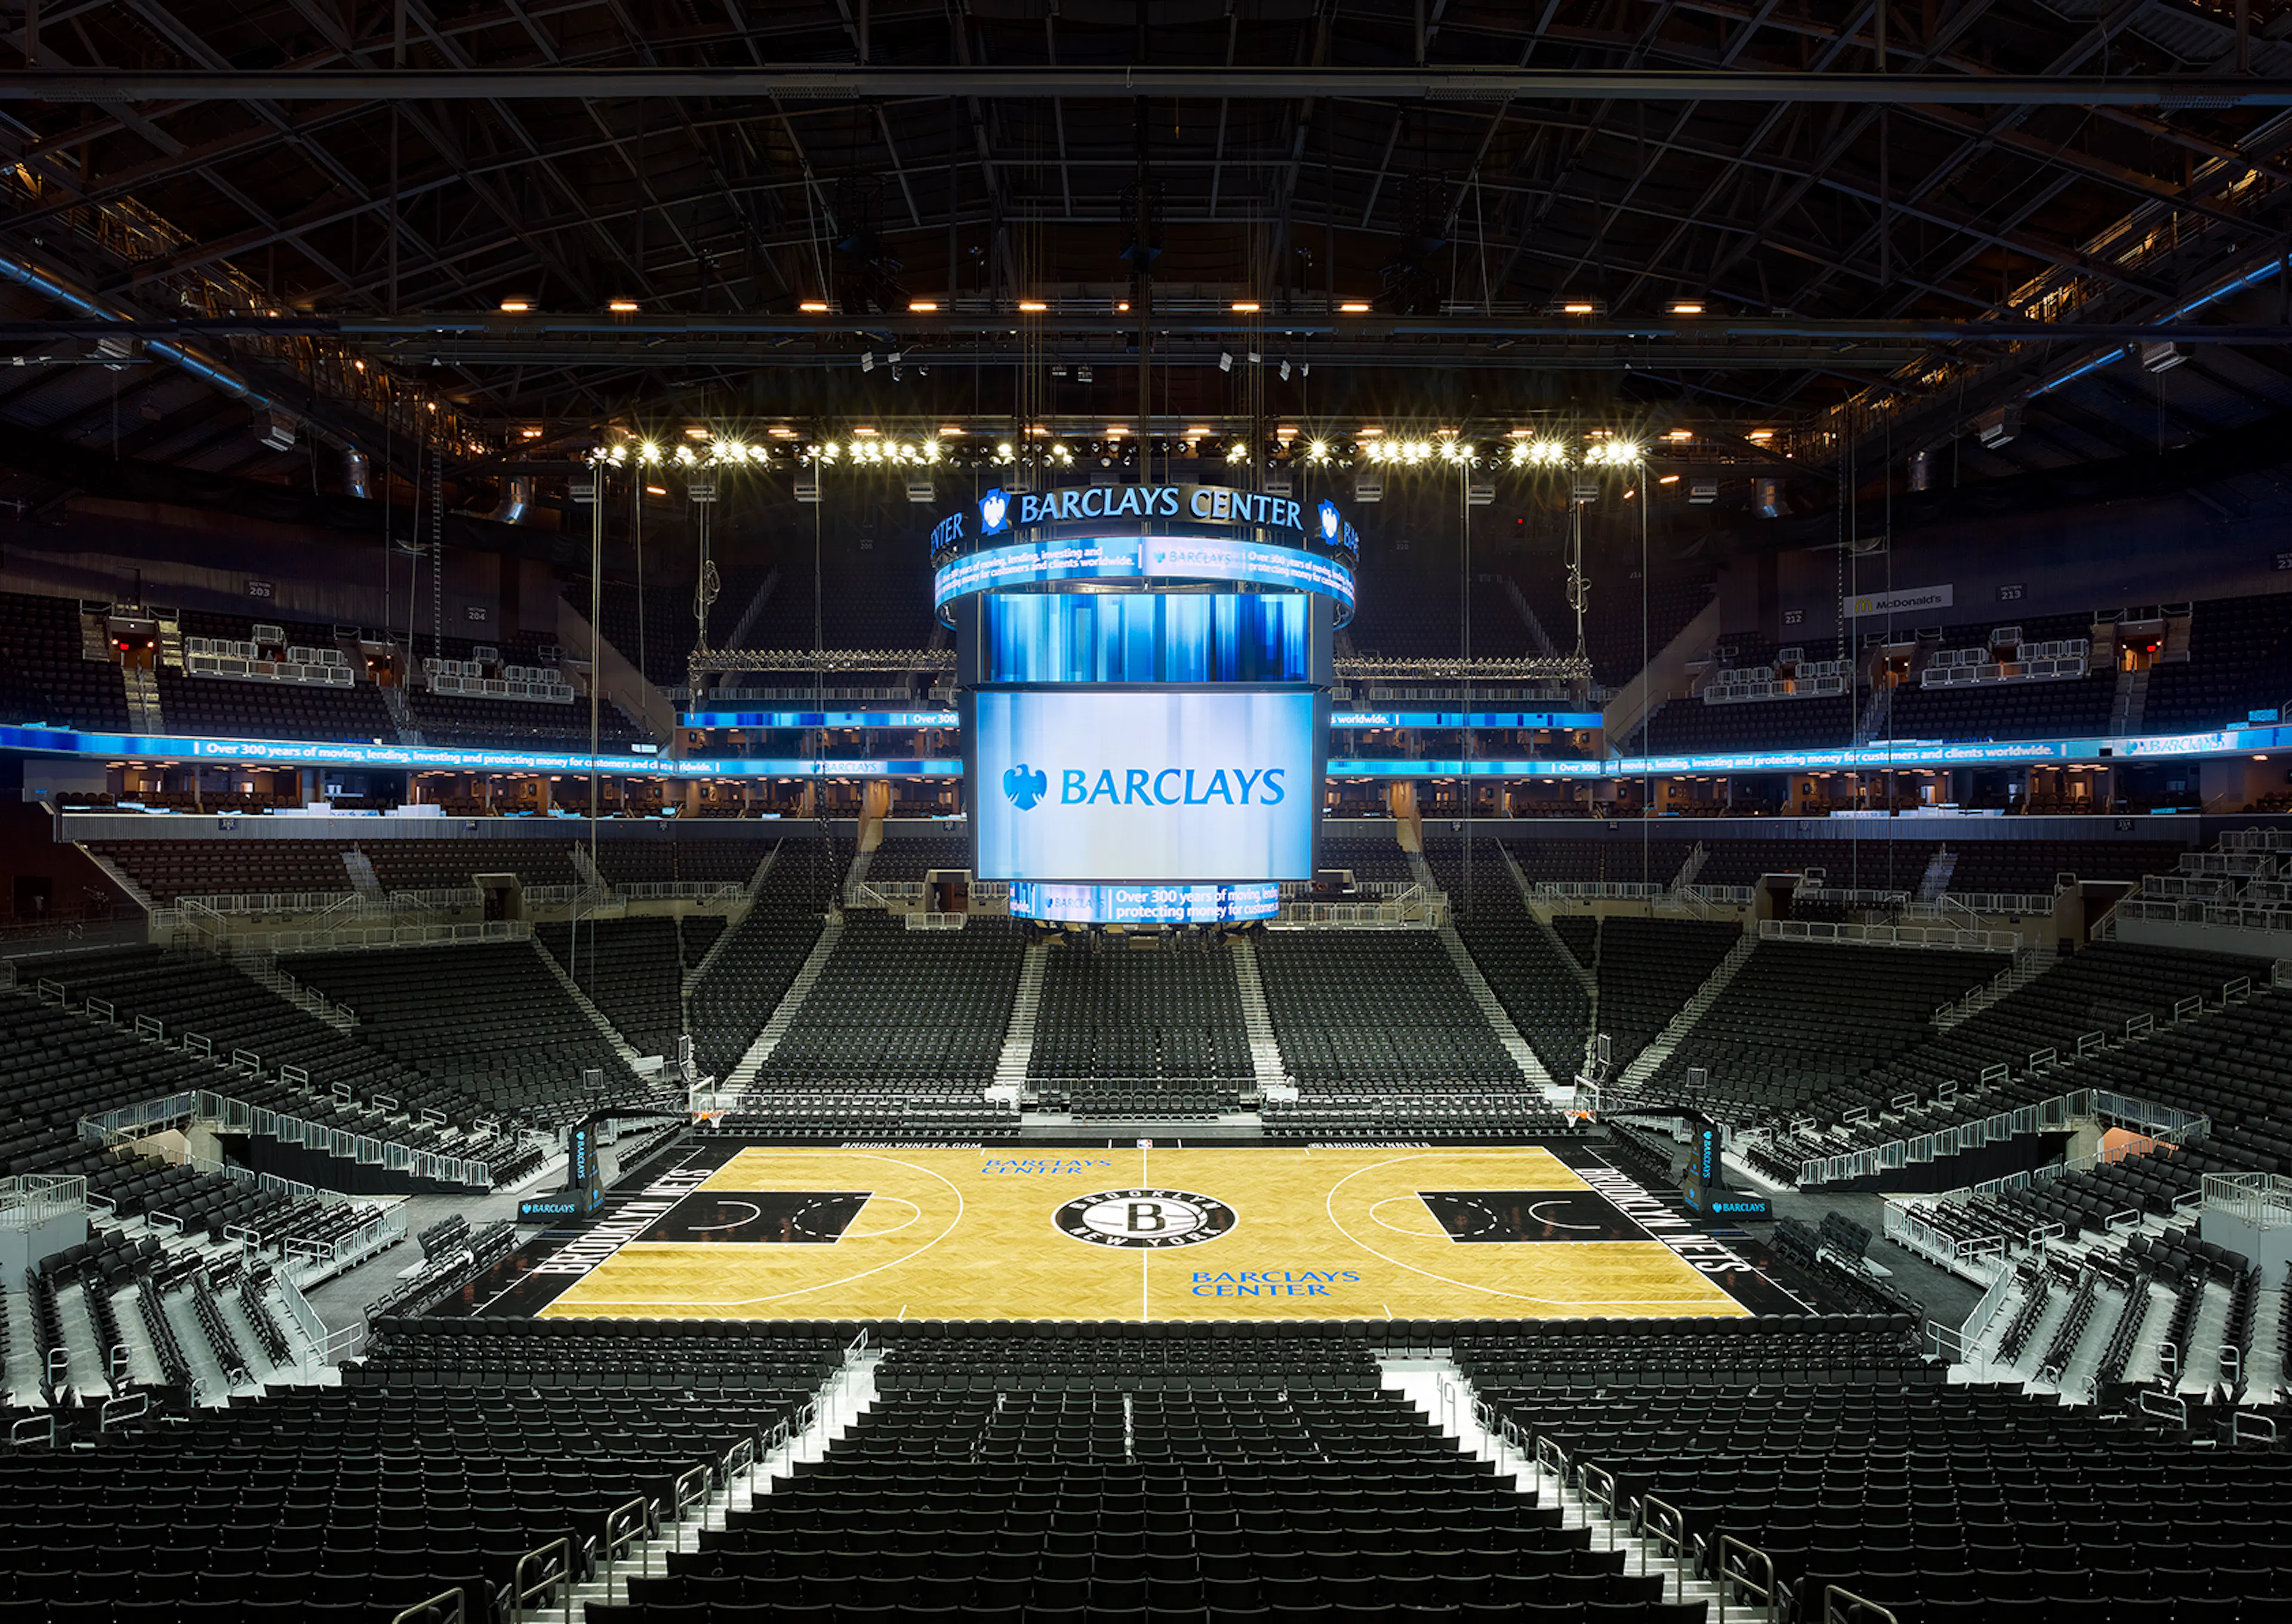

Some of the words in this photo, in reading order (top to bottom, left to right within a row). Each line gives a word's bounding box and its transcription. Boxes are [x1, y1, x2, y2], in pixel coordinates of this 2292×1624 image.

[1020, 487, 1179, 524] BARCLAYS
[1190, 488, 1304, 532] CENTER
[1041, 548, 1083, 560] investing
[1084, 546, 1103, 556] and
[1169, 550, 1231, 565] BARCLAYS
[1248, 551, 1269, 562] Over
[1031, 560, 1047, 571] and
[1048, 559, 1079, 569] clients
[1079, 556, 1135, 567] worldwide.
[1248, 563, 1290, 578] protecting
[249, 587, 271, 597] 203
[2000, 589, 2022, 600] 213
[1876, 594, 1942, 611] McDonald's
[467, 611, 485, 621] 204
[1785, 614, 1803, 625] 212
[913, 714, 936, 723] Over
[938, 714, 957, 723] 300
[1338, 714, 1389, 724] worldwide.
[2143, 733, 2226, 754] BARCLAYS
[206, 742, 238, 753] Over
[241, 744, 266, 755] 300
[268, 747, 301, 758] years
[303, 747, 318, 756] of
[319, 747, 365, 761] moving,
[367, 749, 411, 763] lending,
[413, 751, 461, 765] investing
[462, 753, 482, 763] and
[484, 754, 534, 768] protecting
[536, 758, 568, 769] money
[569, 756, 583, 766] for
[584, 759, 630, 769] customers
[631, 760, 648, 769] and
[1559, 763, 1579, 772] Over
[1581, 763, 1597, 772] 300
[1621, 760, 1654, 772] moving,
[1655, 759, 1690, 770] lending,
[1692, 757, 1733, 769] investing
[1735, 756, 1753, 766] and
[1755, 754, 1806, 768] protecting
[1807, 754, 1843, 766] money
[1844, 751, 1860, 762] for
[1862, 751, 1919, 762] customers
[1921, 748, 1942, 759] and
[1944, 747, 1983, 759] clients
[1986, 745, 2054, 757] worldwide.
[824, 762, 877, 772] BARCLAYS
[1060, 768, 1286, 806] BARCLAYS
[1055, 898, 1105, 909] BARCLAS
[1116, 890, 1149, 902] Over
[1151, 890, 1177, 902] 300
[1179, 890, 1213, 905] years
[1216, 888, 1228, 902] of
[1228, 888, 1262, 904] moving,
[1116, 904, 1185, 920] protecting
[1187, 905, 1227, 919] money
[1228, 902, 1244, 916] for
[577, 1141, 585, 1179] BARCLAYS
[985, 1158, 1113, 1167] BARCLAYS
[1702, 1139, 1712, 1179] BARCLAYS
[1068, 1190, 1222, 1210] BROOKLYN
[1723, 1202, 1766, 1213] BARCLAYS
[531, 1203, 575, 1214] BARCLAYS
[533, 1201, 673, 1274] BROOKLYN
[640, 1168, 714, 1197] NETS
[1127, 1203, 1166, 1232] B
[1574, 1167, 1693, 1228] BROOKLYN
[1657, 1234, 1752, 1273] NETS
[1069, 1227, 1129, 1246] NEW
[1145, 1228, 1222, 1247] YORK
[1192, 1271, 1361, 1283] BARCLAYS
[1191, 1284, 1332, 1296] CENTER
